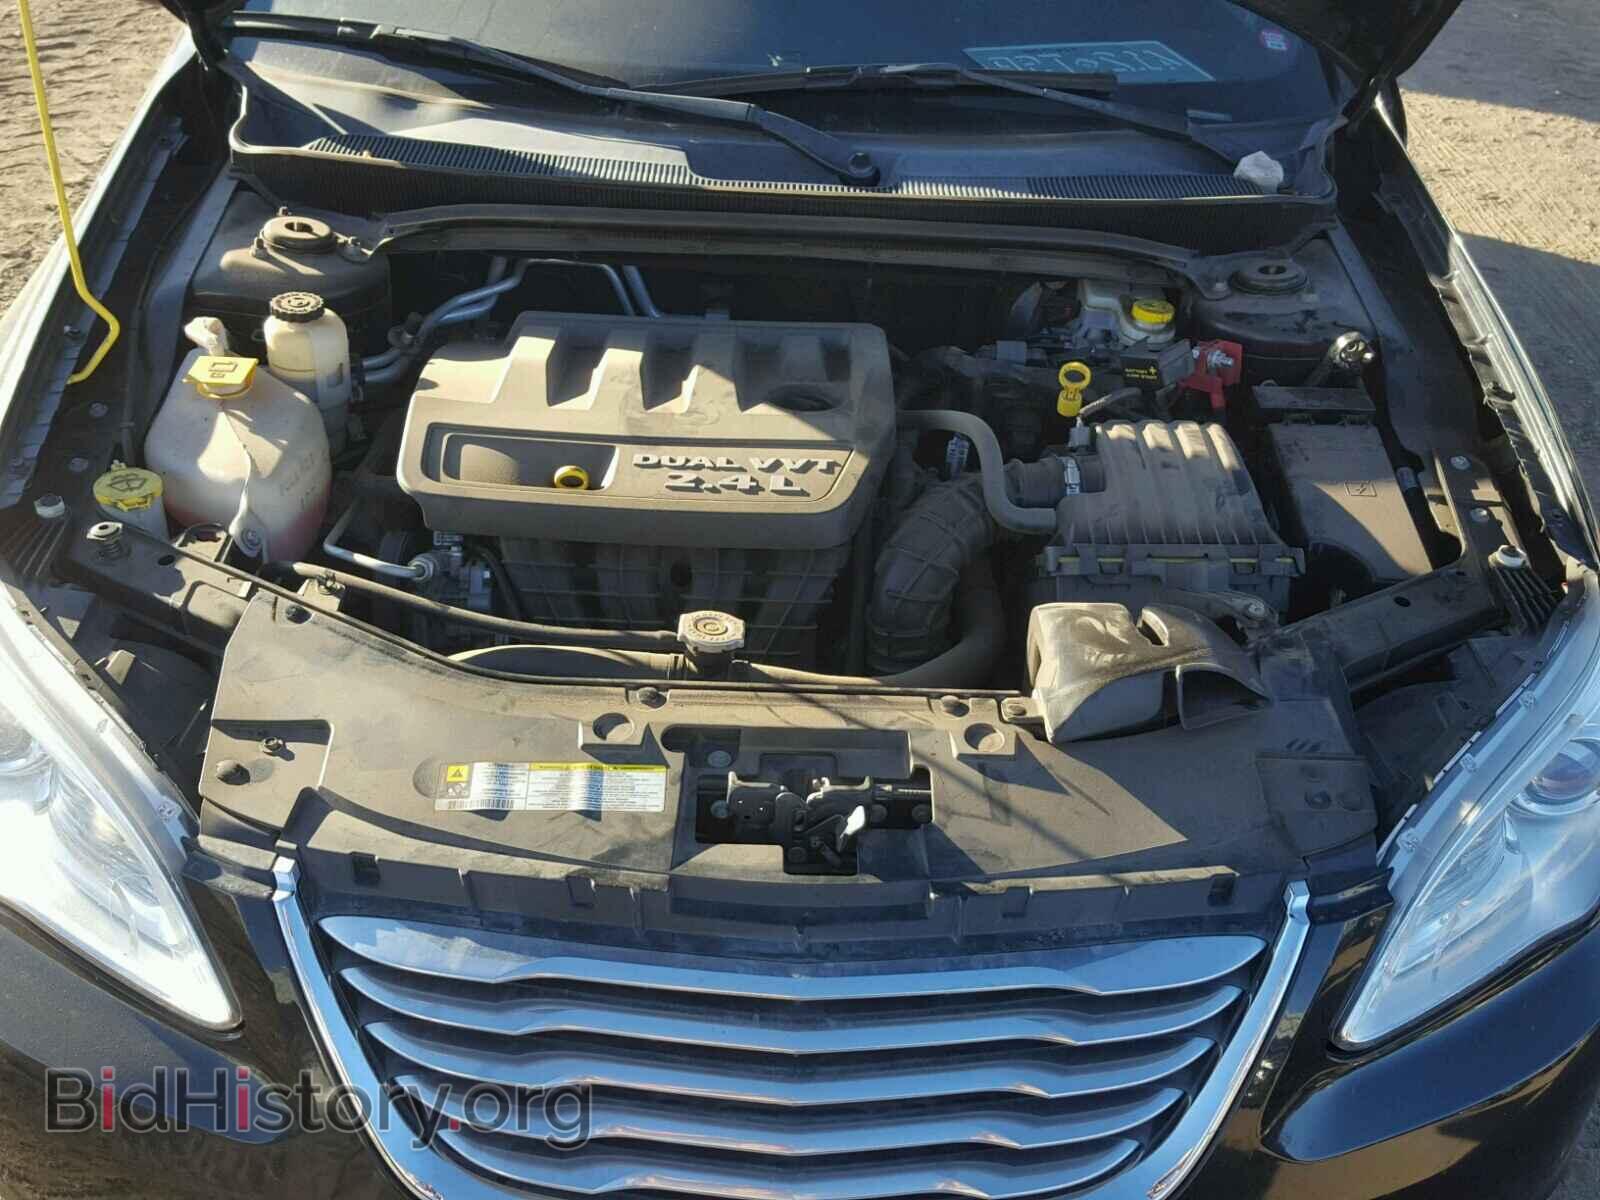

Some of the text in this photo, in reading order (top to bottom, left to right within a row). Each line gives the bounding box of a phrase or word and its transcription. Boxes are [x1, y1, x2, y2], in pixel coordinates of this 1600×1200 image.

[633, 453, 842, 474] DUAL VVT
[664, 472, 809, 496] 2.4L
